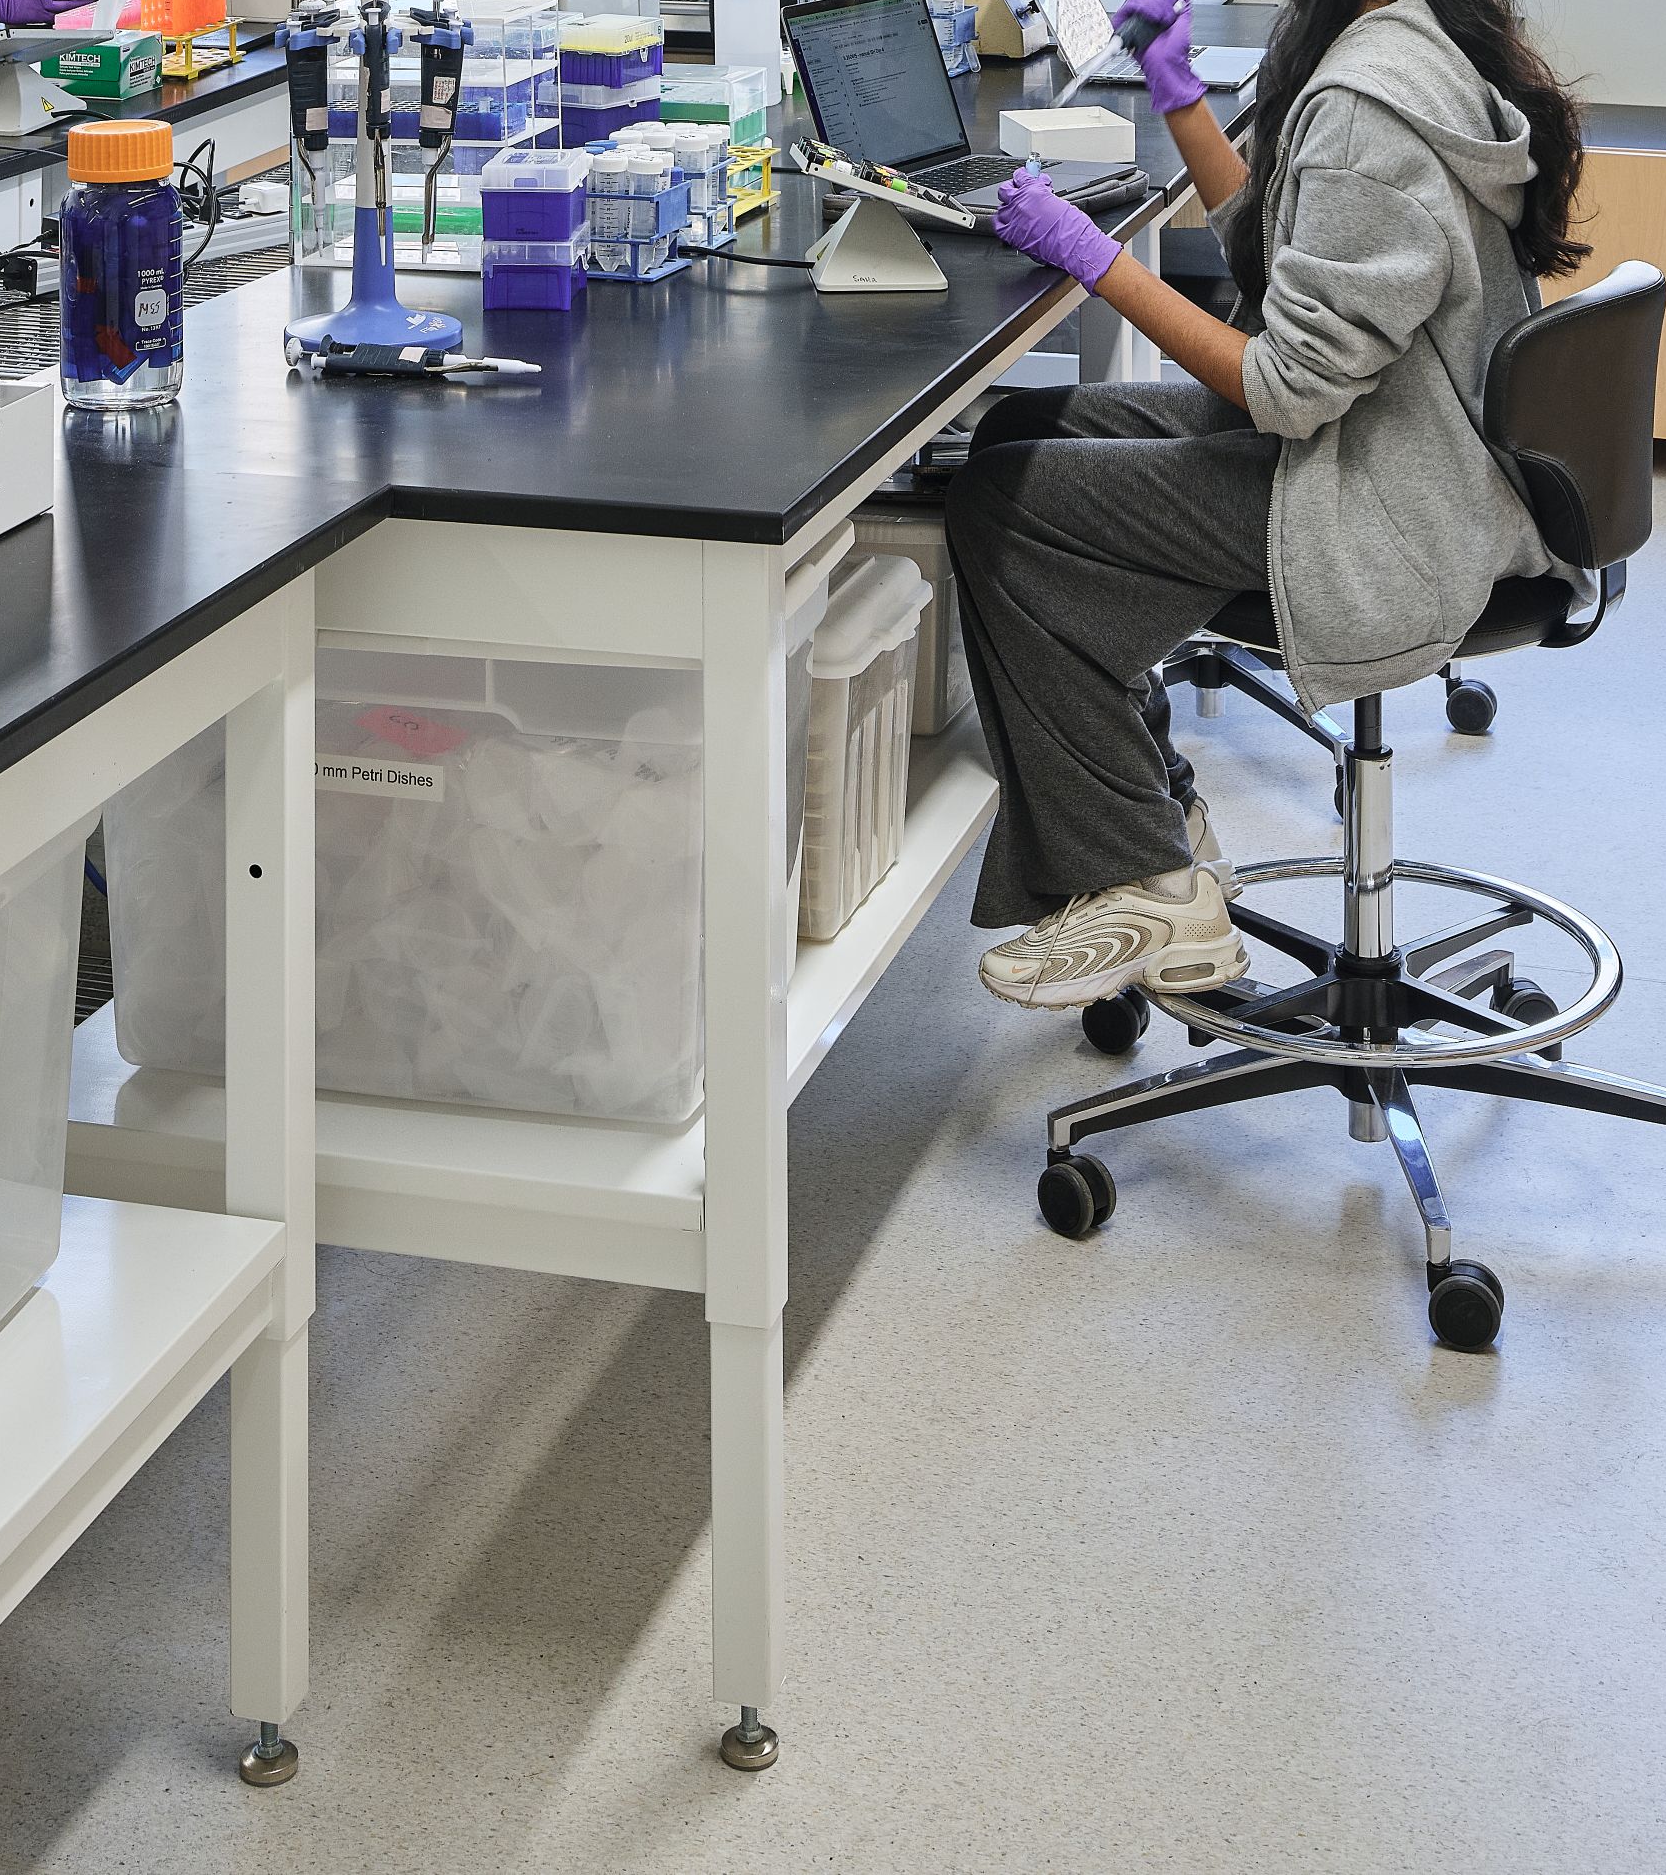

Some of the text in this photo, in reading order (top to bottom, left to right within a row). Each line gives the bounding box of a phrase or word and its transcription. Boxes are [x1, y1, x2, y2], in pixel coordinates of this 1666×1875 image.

[59, 54, 101, 62] KIMTECH
[129, 56, 156, 73] KIMTECH
[137, 270, 155, 278] 1000
[323, 766, 434, 787] mm Petri Dishes
